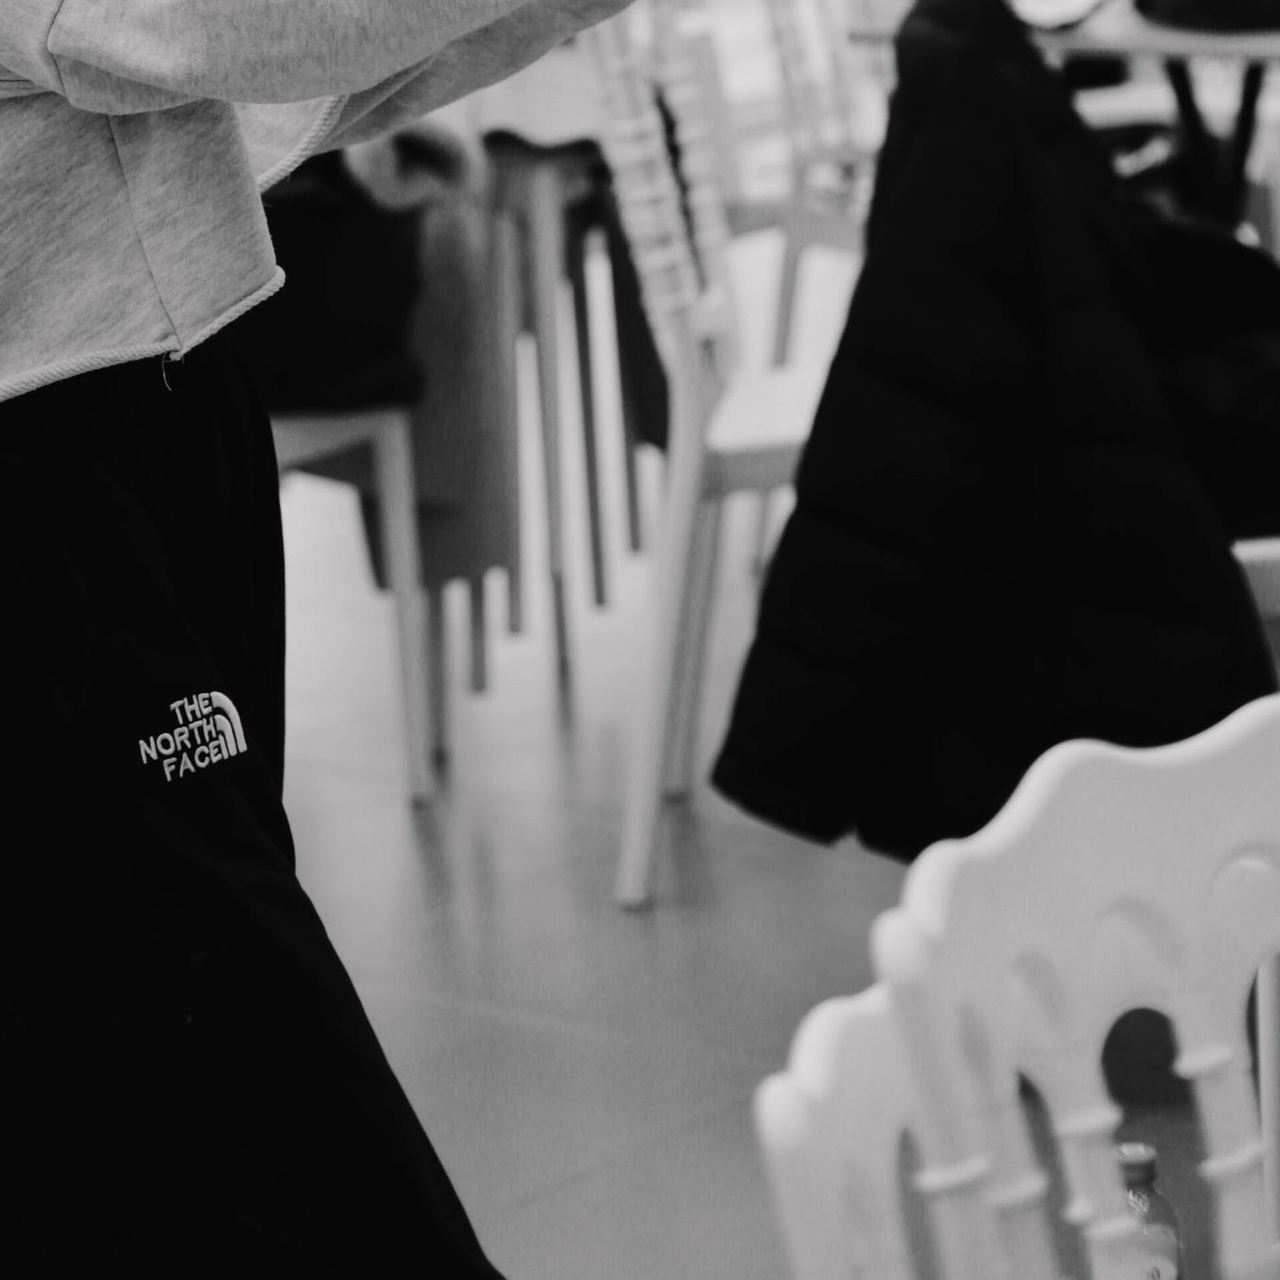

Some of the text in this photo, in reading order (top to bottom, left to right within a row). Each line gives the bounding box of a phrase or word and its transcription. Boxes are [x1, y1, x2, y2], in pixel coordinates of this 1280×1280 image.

[170, 693, 212, 724] THE
[139, 716, 216, 764] NORTH
[163, 741, 222, 782] FACE
